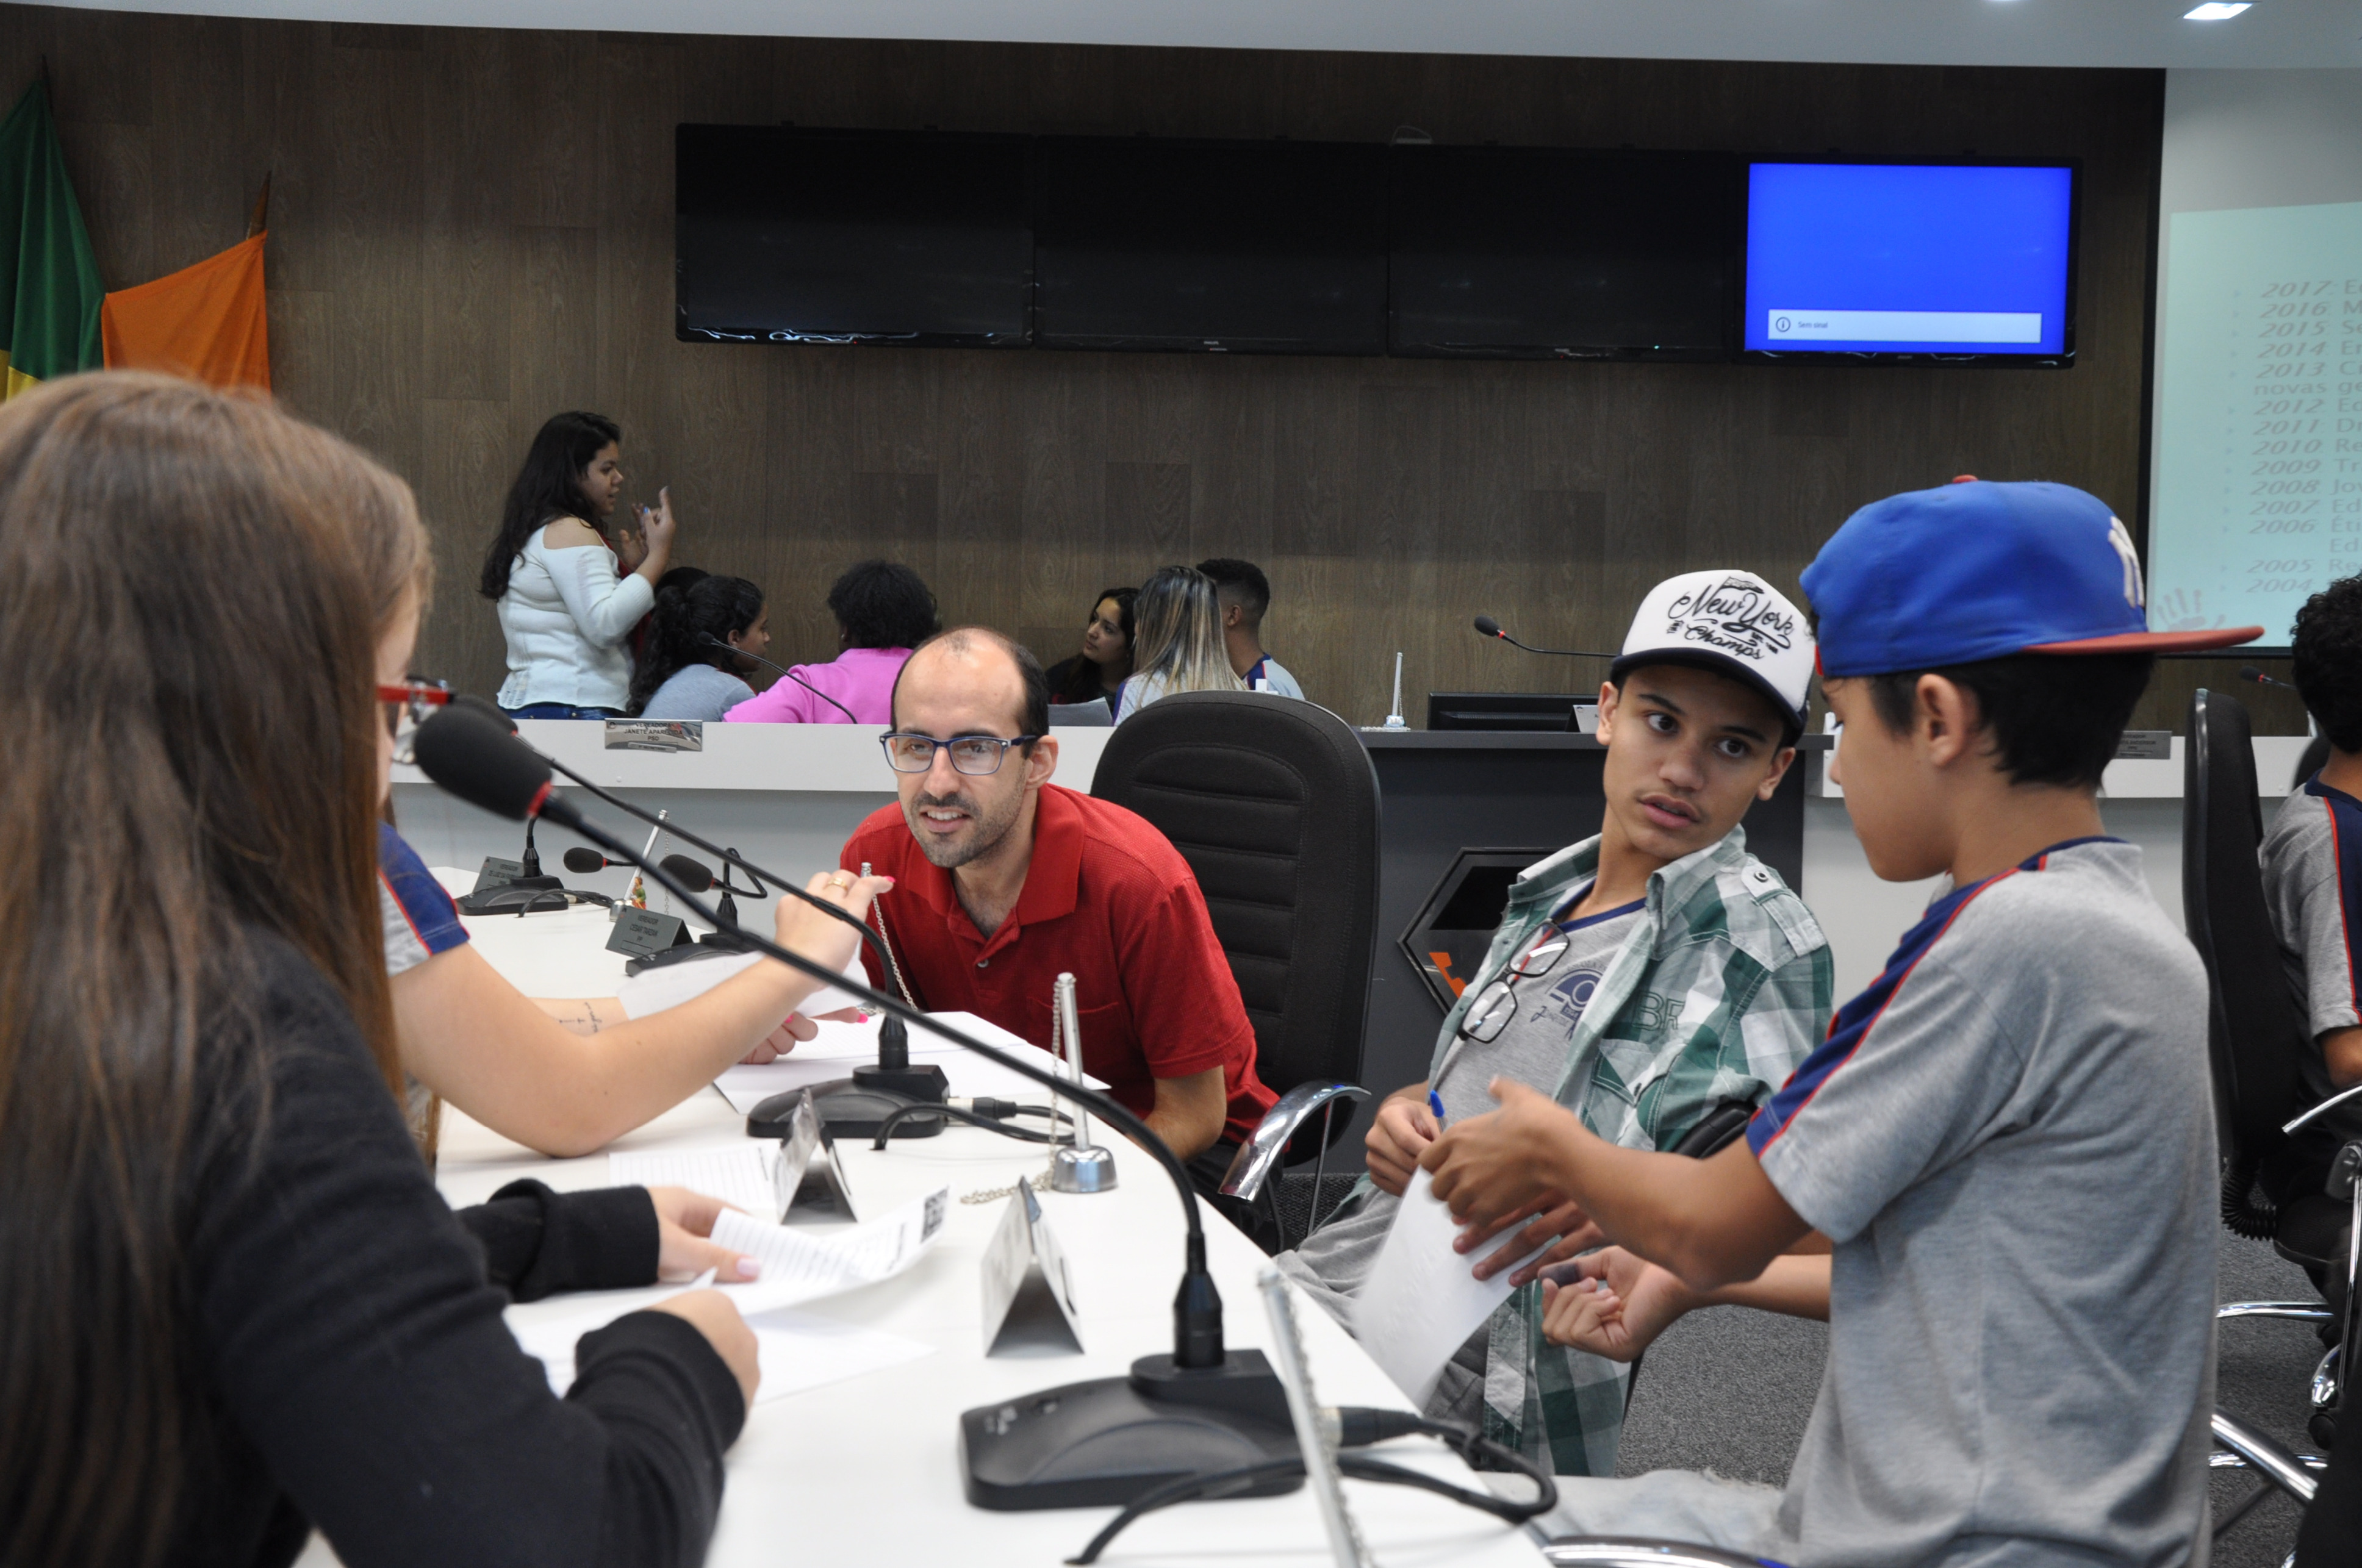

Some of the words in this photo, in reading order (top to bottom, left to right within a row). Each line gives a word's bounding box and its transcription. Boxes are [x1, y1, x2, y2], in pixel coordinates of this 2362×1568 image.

[2253, 382, 2327, 396] novas
[1668, 584, 1744, 620] New
[1739, 592, 1795, 635] York
